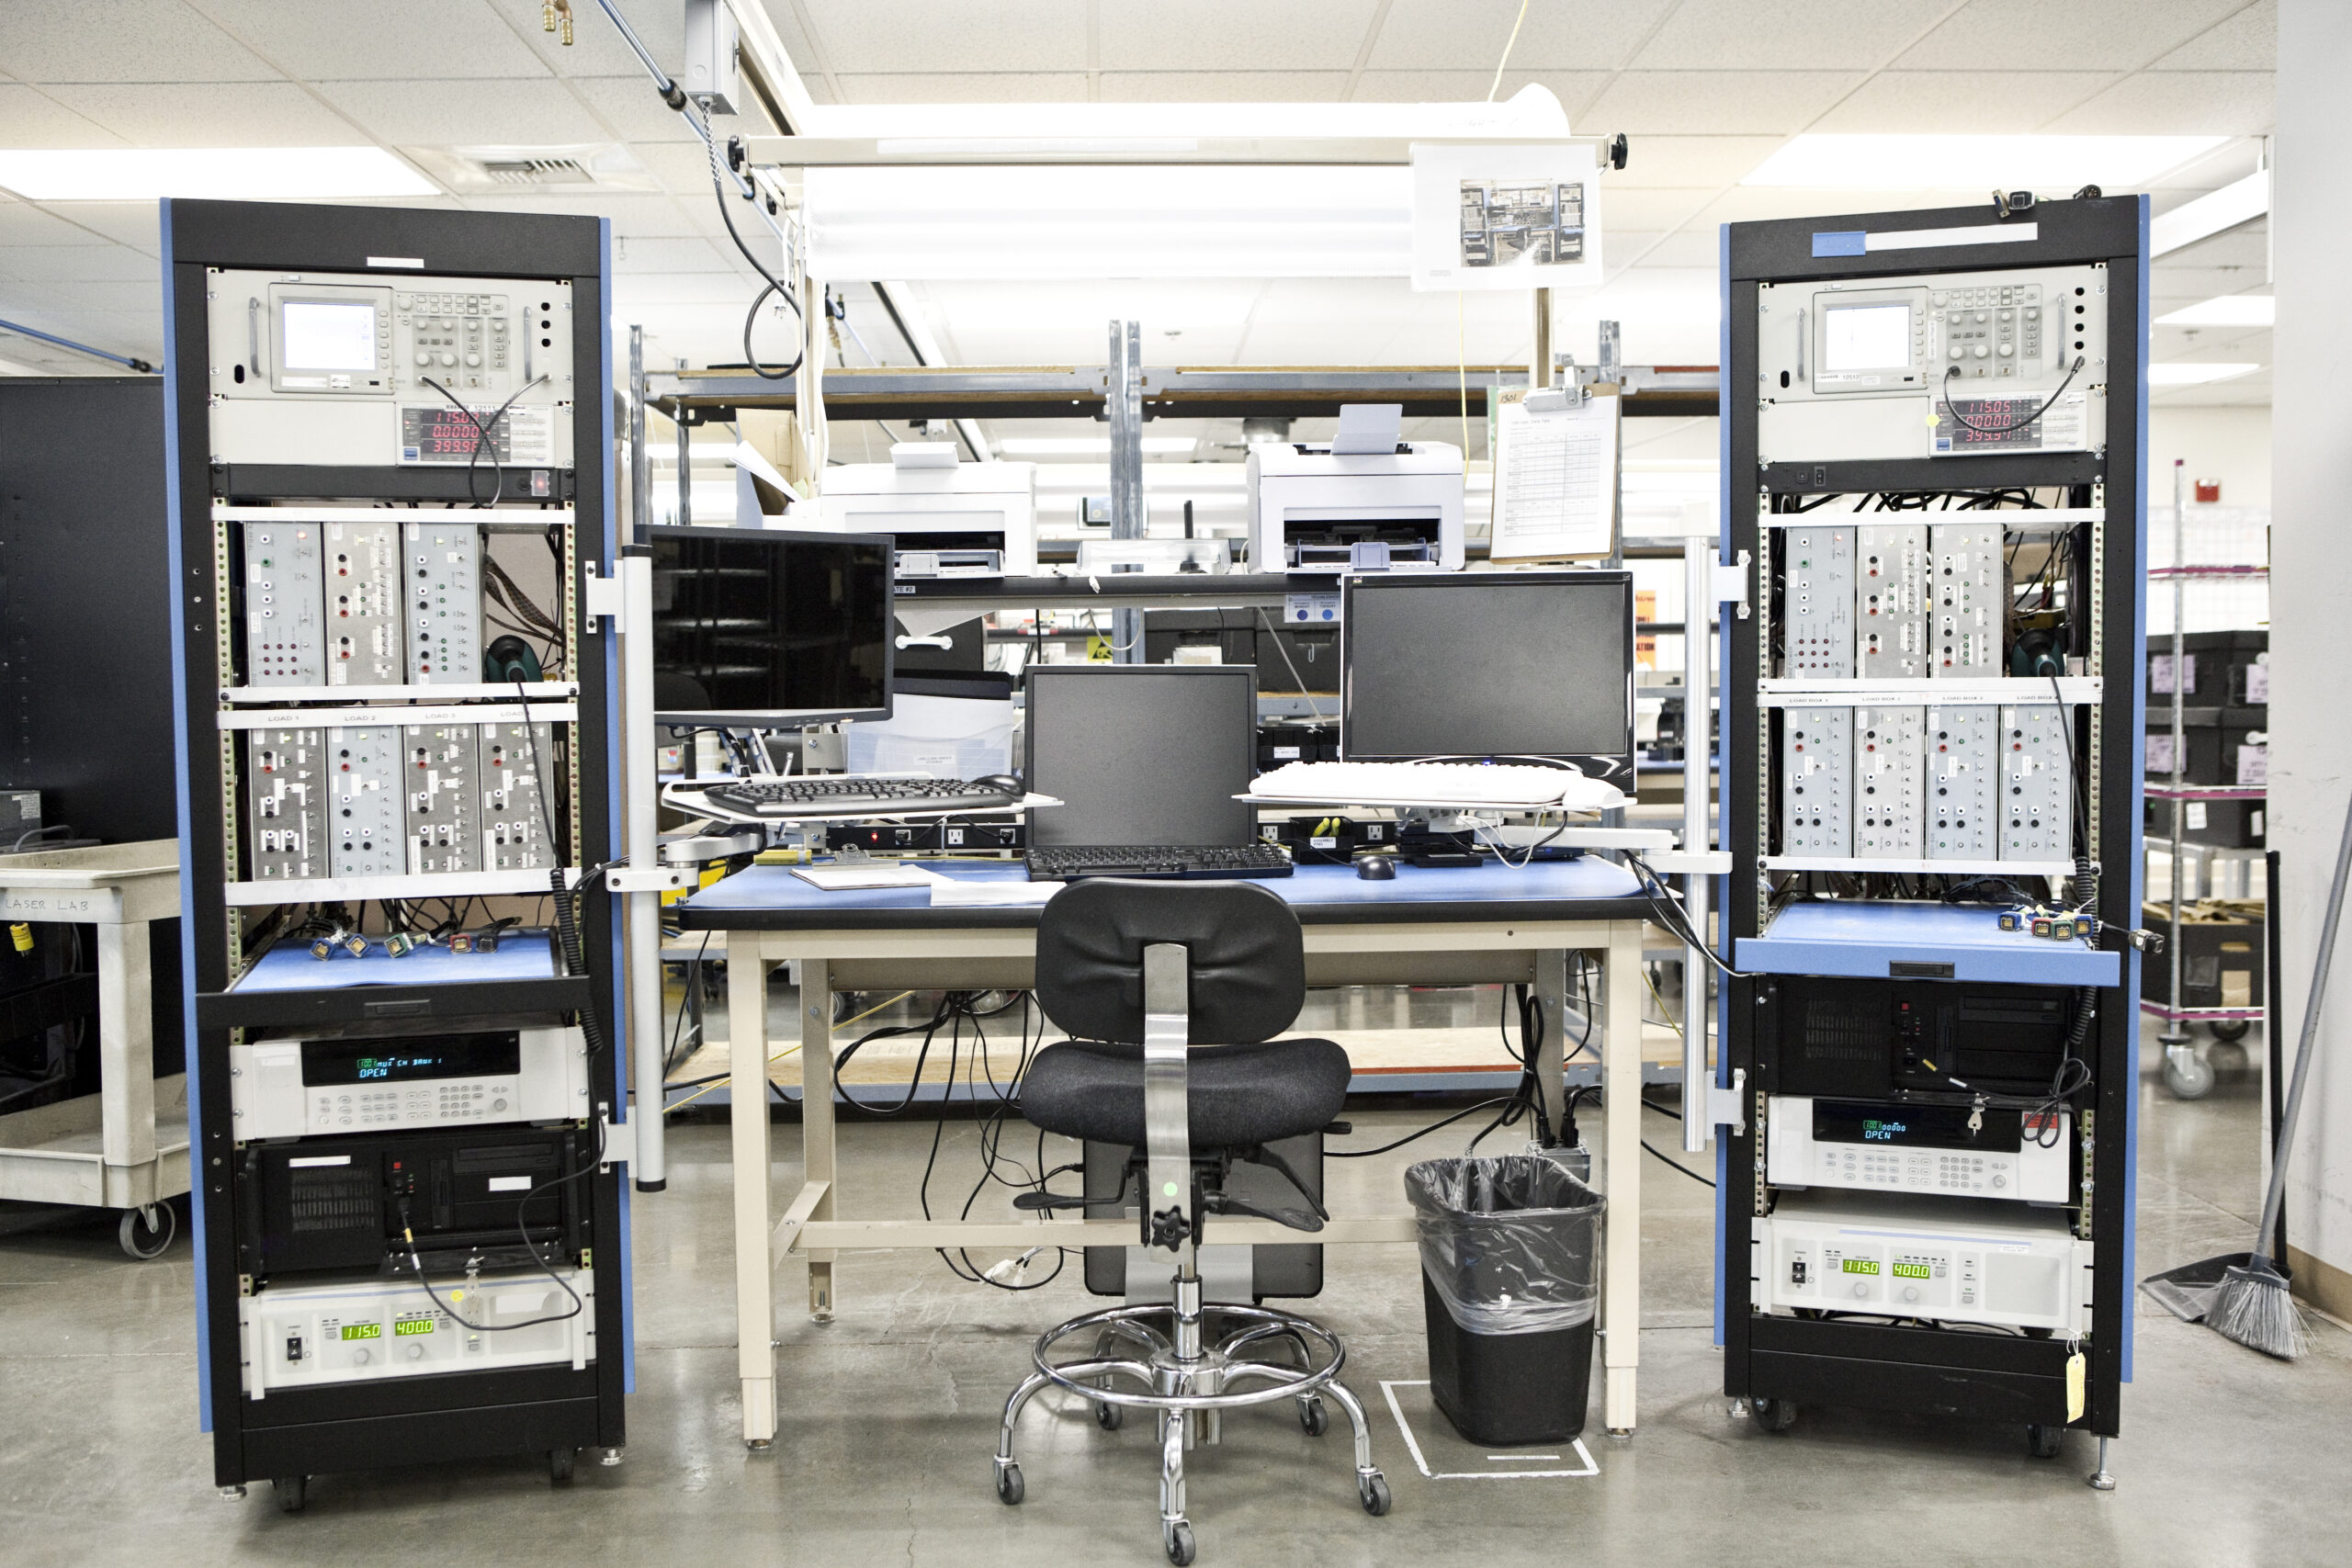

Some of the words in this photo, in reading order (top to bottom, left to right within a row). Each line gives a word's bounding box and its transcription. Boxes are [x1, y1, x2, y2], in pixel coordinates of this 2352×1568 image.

[1499, 393, 1517, 403] 1301
[433, 426, 480, 438] 0.0000
[6, 899, 46, 909] LASER
[58, 900, 89, 911] LAB
[358, 1068, 388, 1078] OPEN
[1864, 1130, 1892, 1139] OPEN
[1848, 1261, 1880, 1274] 115.0
[1894, 1264, 1929, 1277] 400.0
[348, 1325, 380, 1338] 115.0
[396, 1320, 433, 1334] 400.0
